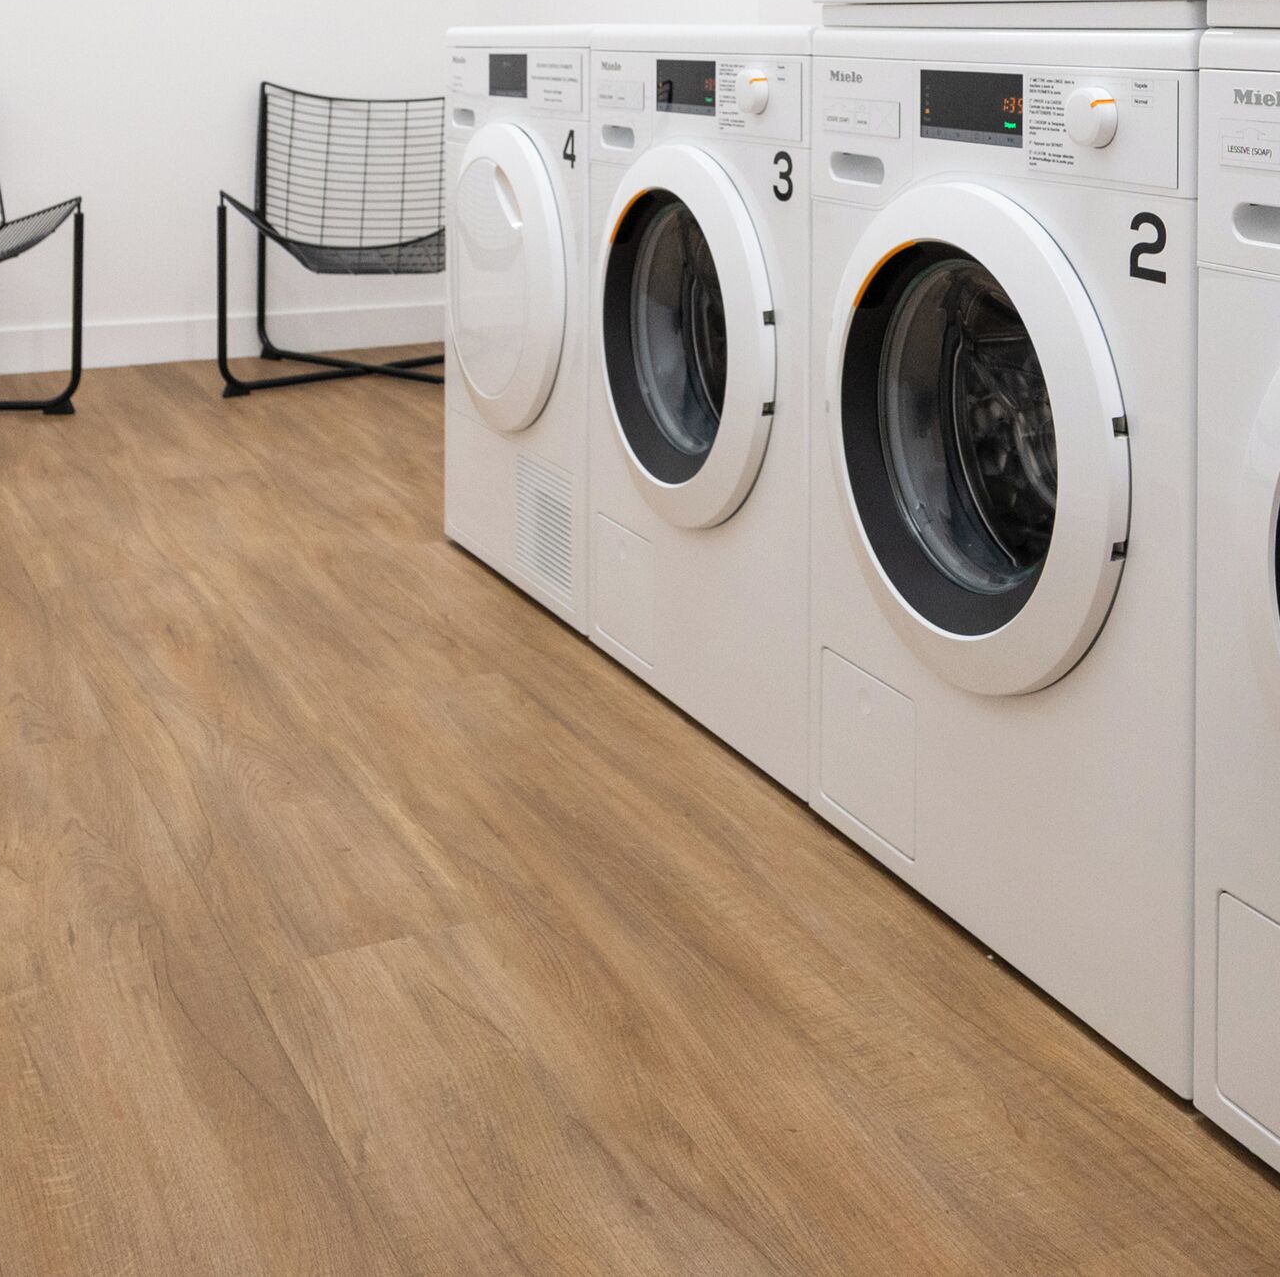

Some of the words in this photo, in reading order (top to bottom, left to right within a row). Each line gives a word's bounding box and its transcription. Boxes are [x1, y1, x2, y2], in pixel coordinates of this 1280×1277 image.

[830, 70, 863, 83] Miele
[563, 130, 576, 169] 4
[1227, 145, 1250, 155] LESSIVE
[1251, 148, 1272, 159] (SOAP)
[773, 151, 793, 202] 3
[1130, 211, 1166, 284] 2
